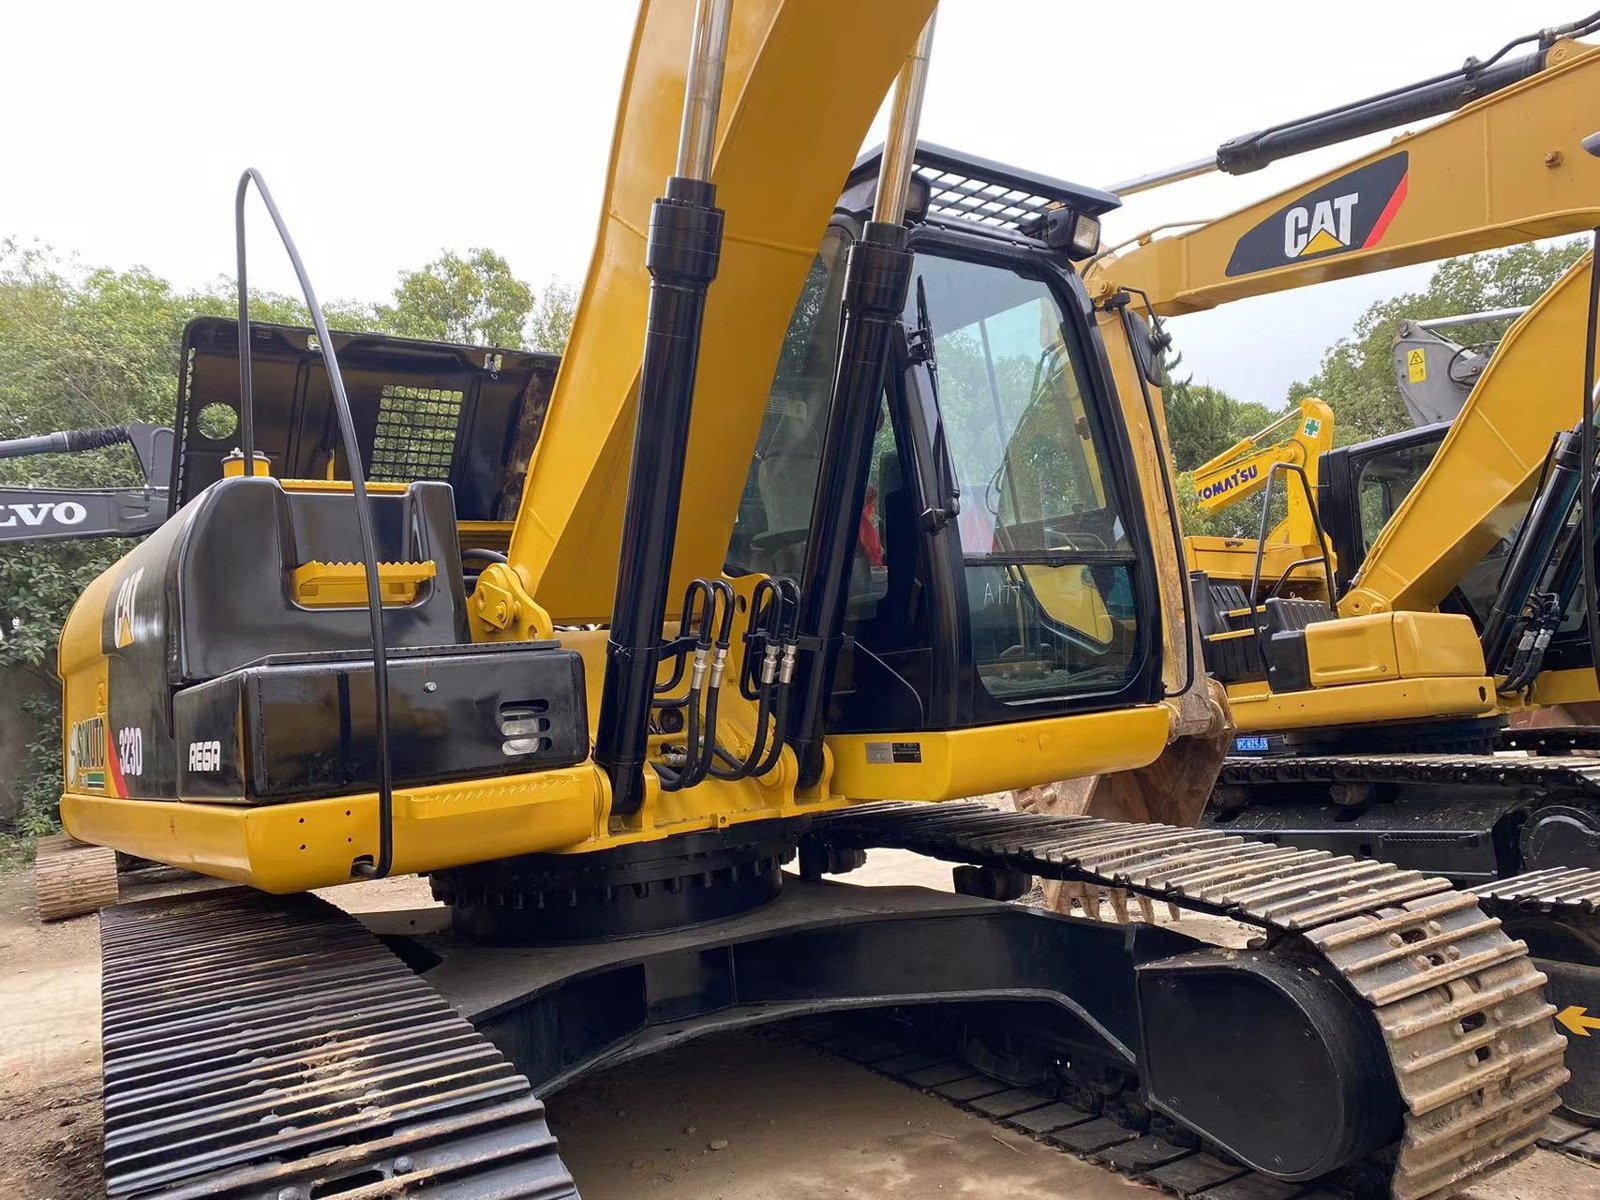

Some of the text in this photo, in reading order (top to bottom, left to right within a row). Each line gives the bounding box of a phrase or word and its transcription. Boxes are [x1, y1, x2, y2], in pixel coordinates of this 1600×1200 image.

[1285, 192, 1359, 258] CAT
[114, 566, 145, 649] CAT
[118, 726, 143, 776] 323D
[188, 740, 221, 772] REGA
